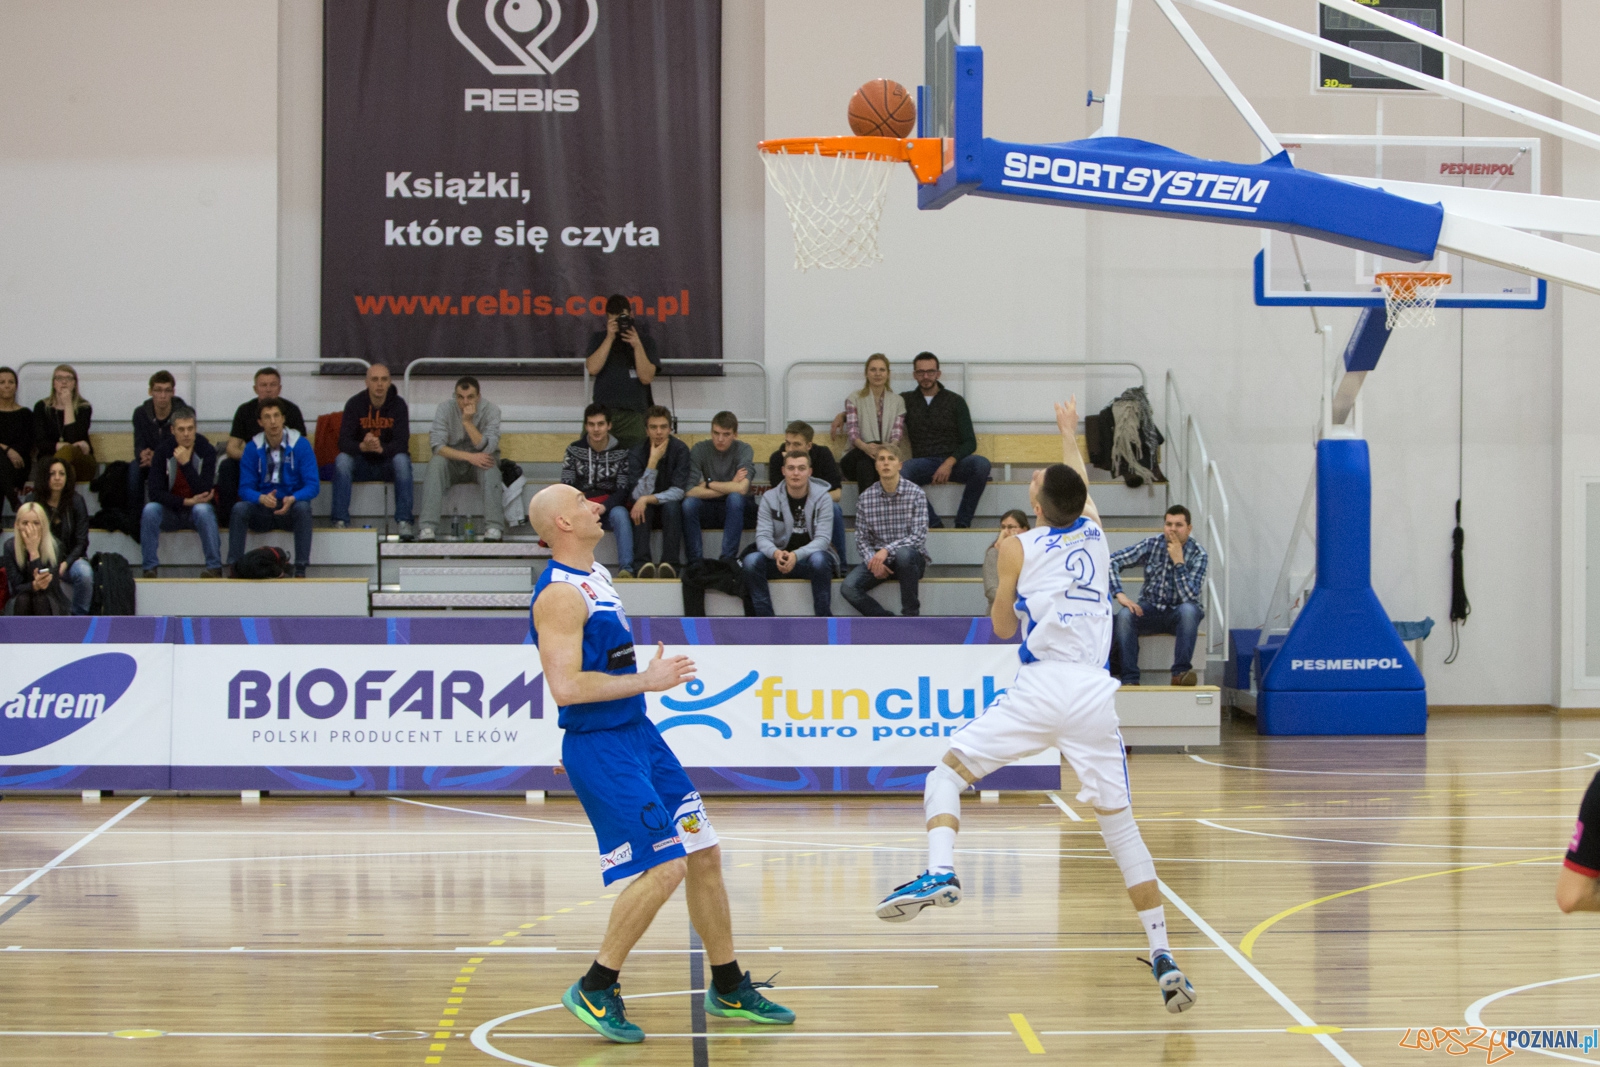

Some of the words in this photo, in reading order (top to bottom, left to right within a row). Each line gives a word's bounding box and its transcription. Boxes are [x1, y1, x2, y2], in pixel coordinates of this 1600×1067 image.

[464, 88, 580, 112] REBIS
[1440, 162, 1515, 176] PESMENPOL
[385, 171, 531, 205] Książki,
[384, 219, 482, 247] które
[494, 219, 549, 252] się
[560, 221, 660, 253] czyta
[1065, 548, 1101, 603] 2
[1291, 658, 1403, 670] PESMENPOL
[4, 687, 106, 719] atrem
[227, 667, 544, 719] BIOFARM
[252, 730, 319, 743] POLSKI
[330, 730, 443, 743] PRODUCENT
[456, 727, 519, 743] LEKÓW
[761, 722, 857, 738] biuro
